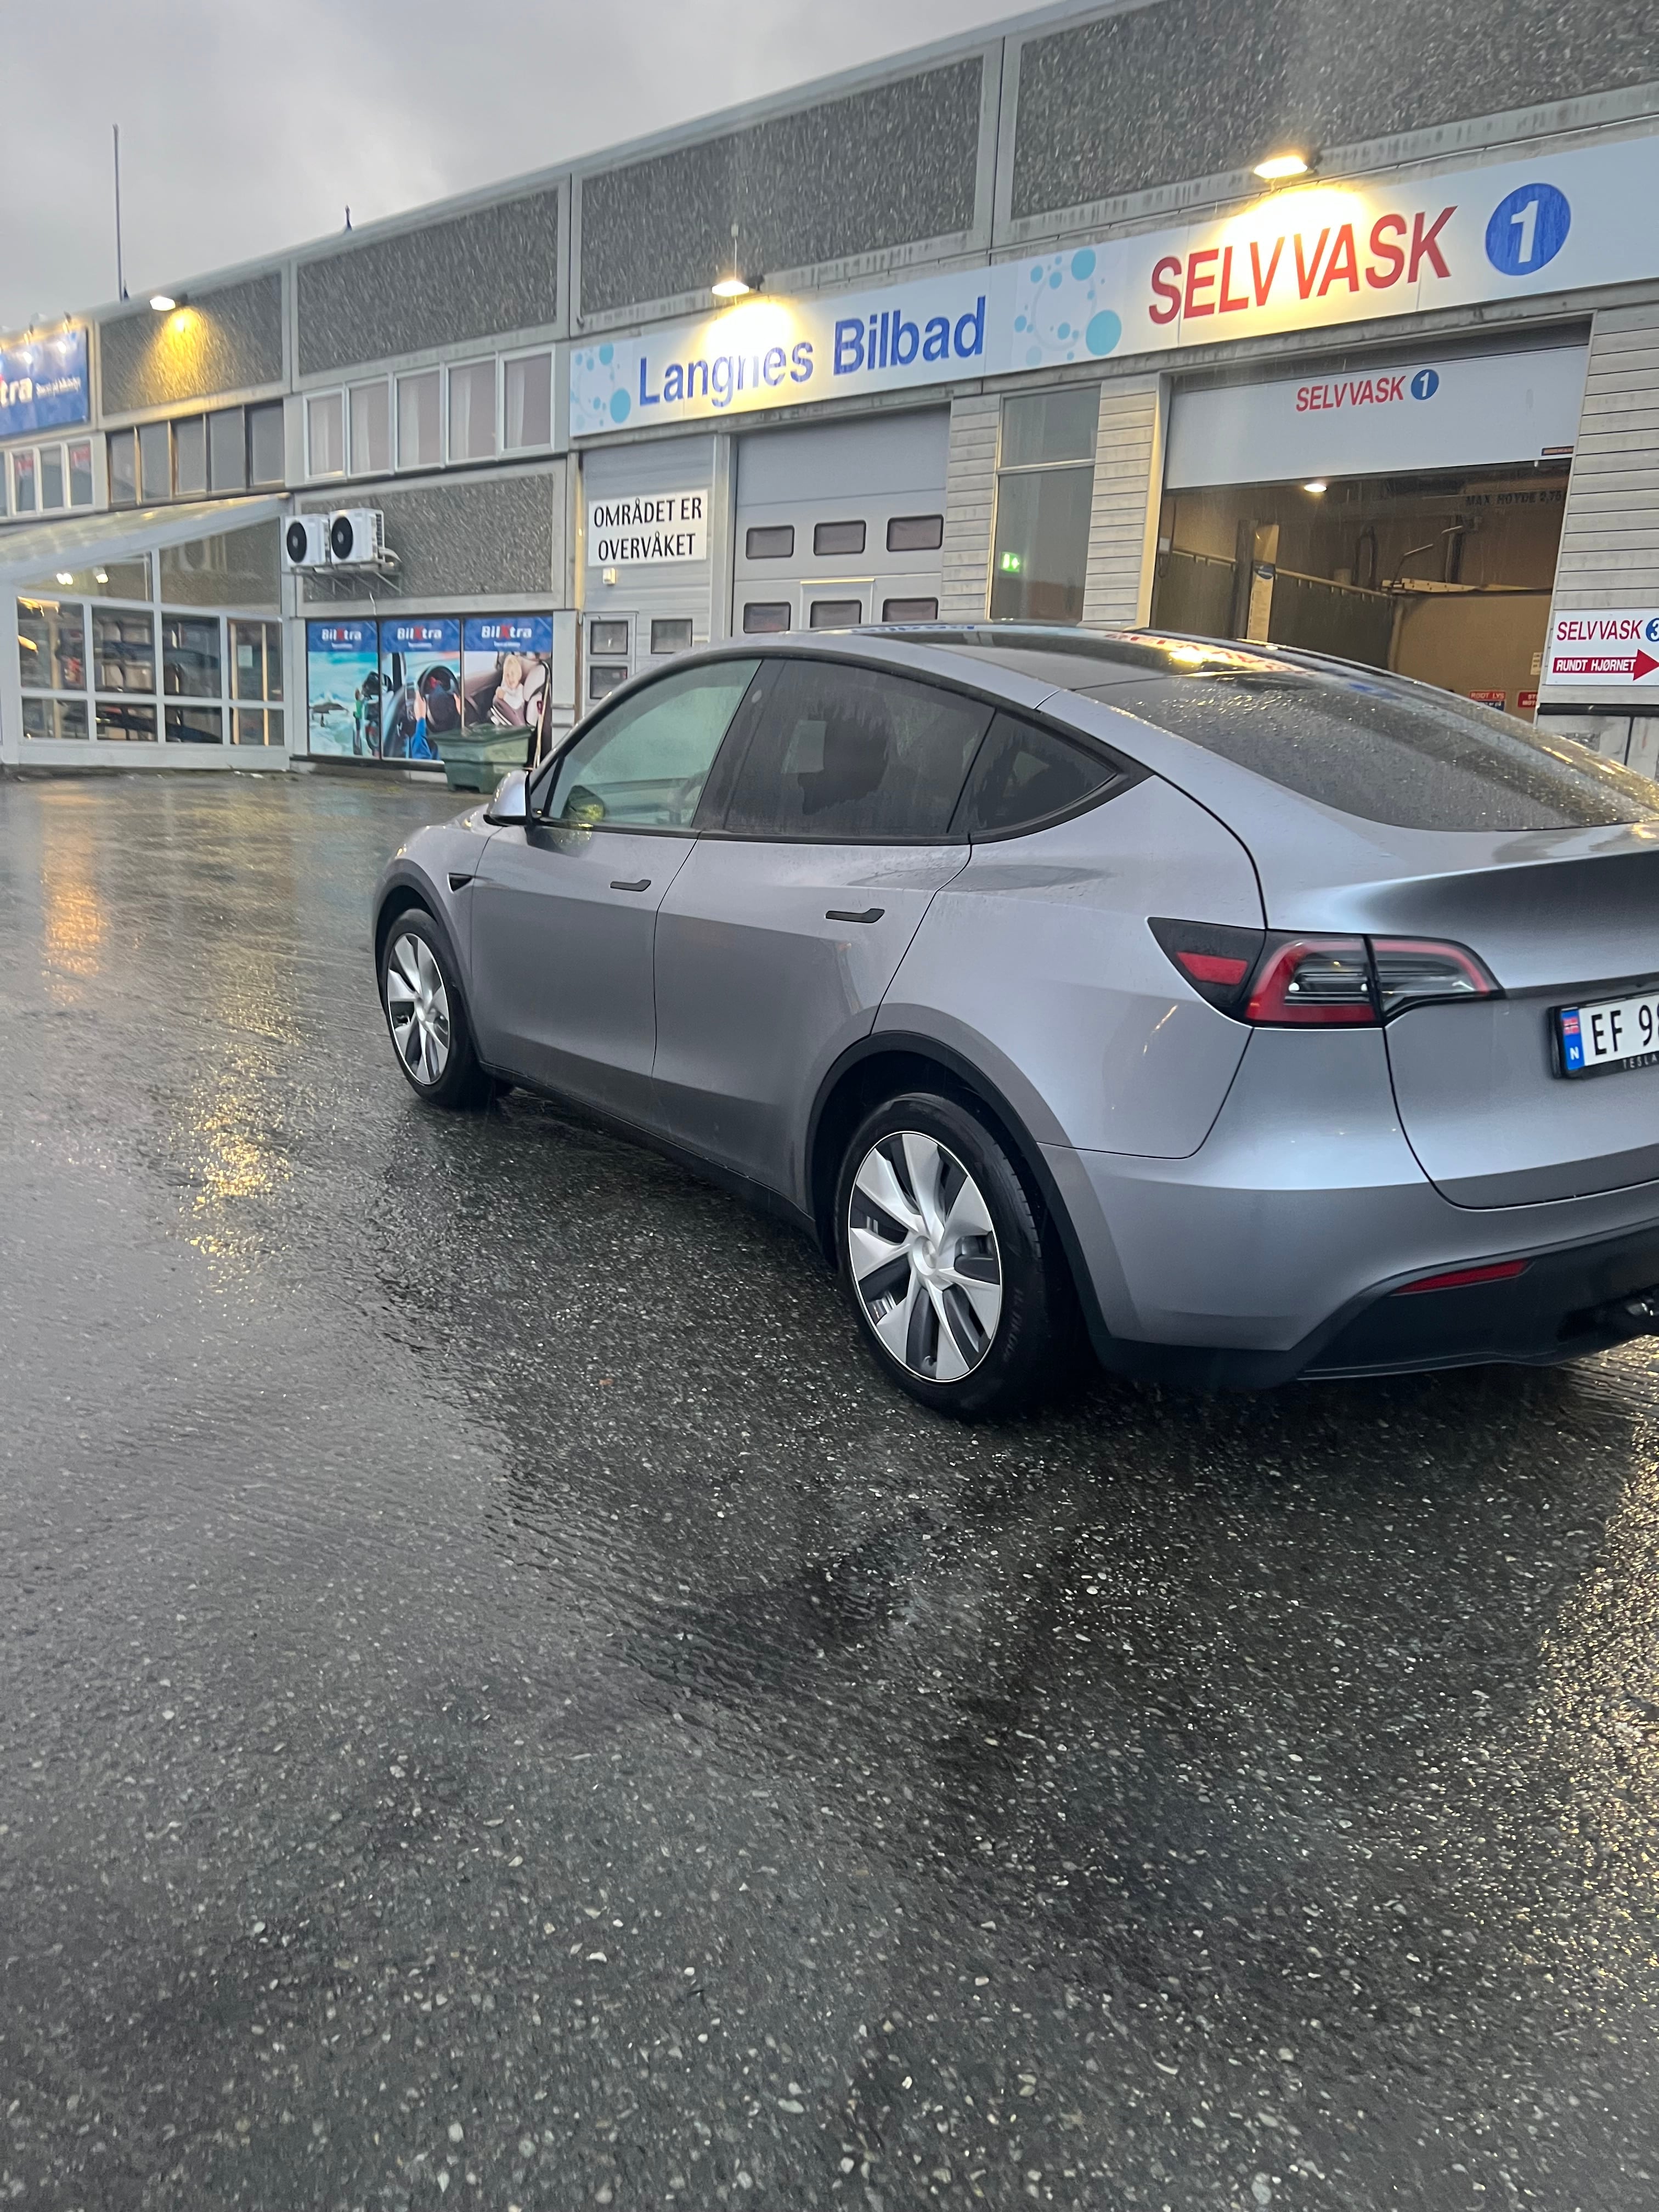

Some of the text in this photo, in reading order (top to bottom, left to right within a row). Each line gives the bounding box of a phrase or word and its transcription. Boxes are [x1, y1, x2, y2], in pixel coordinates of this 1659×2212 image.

[1511, 199, 1539, 264] 1
[639, 295, 986, 408] Langnes Bilbad
[0, 377, 33, 408] tra
[1296, 372, 1430, 411] SELVVASK 1
[594, 497, 702, 528] OMRÅDET ER
[598, 531, 696, 561] OVERVÅKET
[321, 627, 362, 641] BilXtra
[397, 625, 442, 641] BilXtra
[481, 624, 532, 640] BilXtra
[1556, 619, 1659, 641] SELVVASK 3
[1556, 659, 1637, 672] RUNDT HJØRNET
[1591, 1003, 1659, 1056] EF 9
[1570, 1046, 1579, 1060] N
[1623, 1054, 1657, 1069] TESLA
